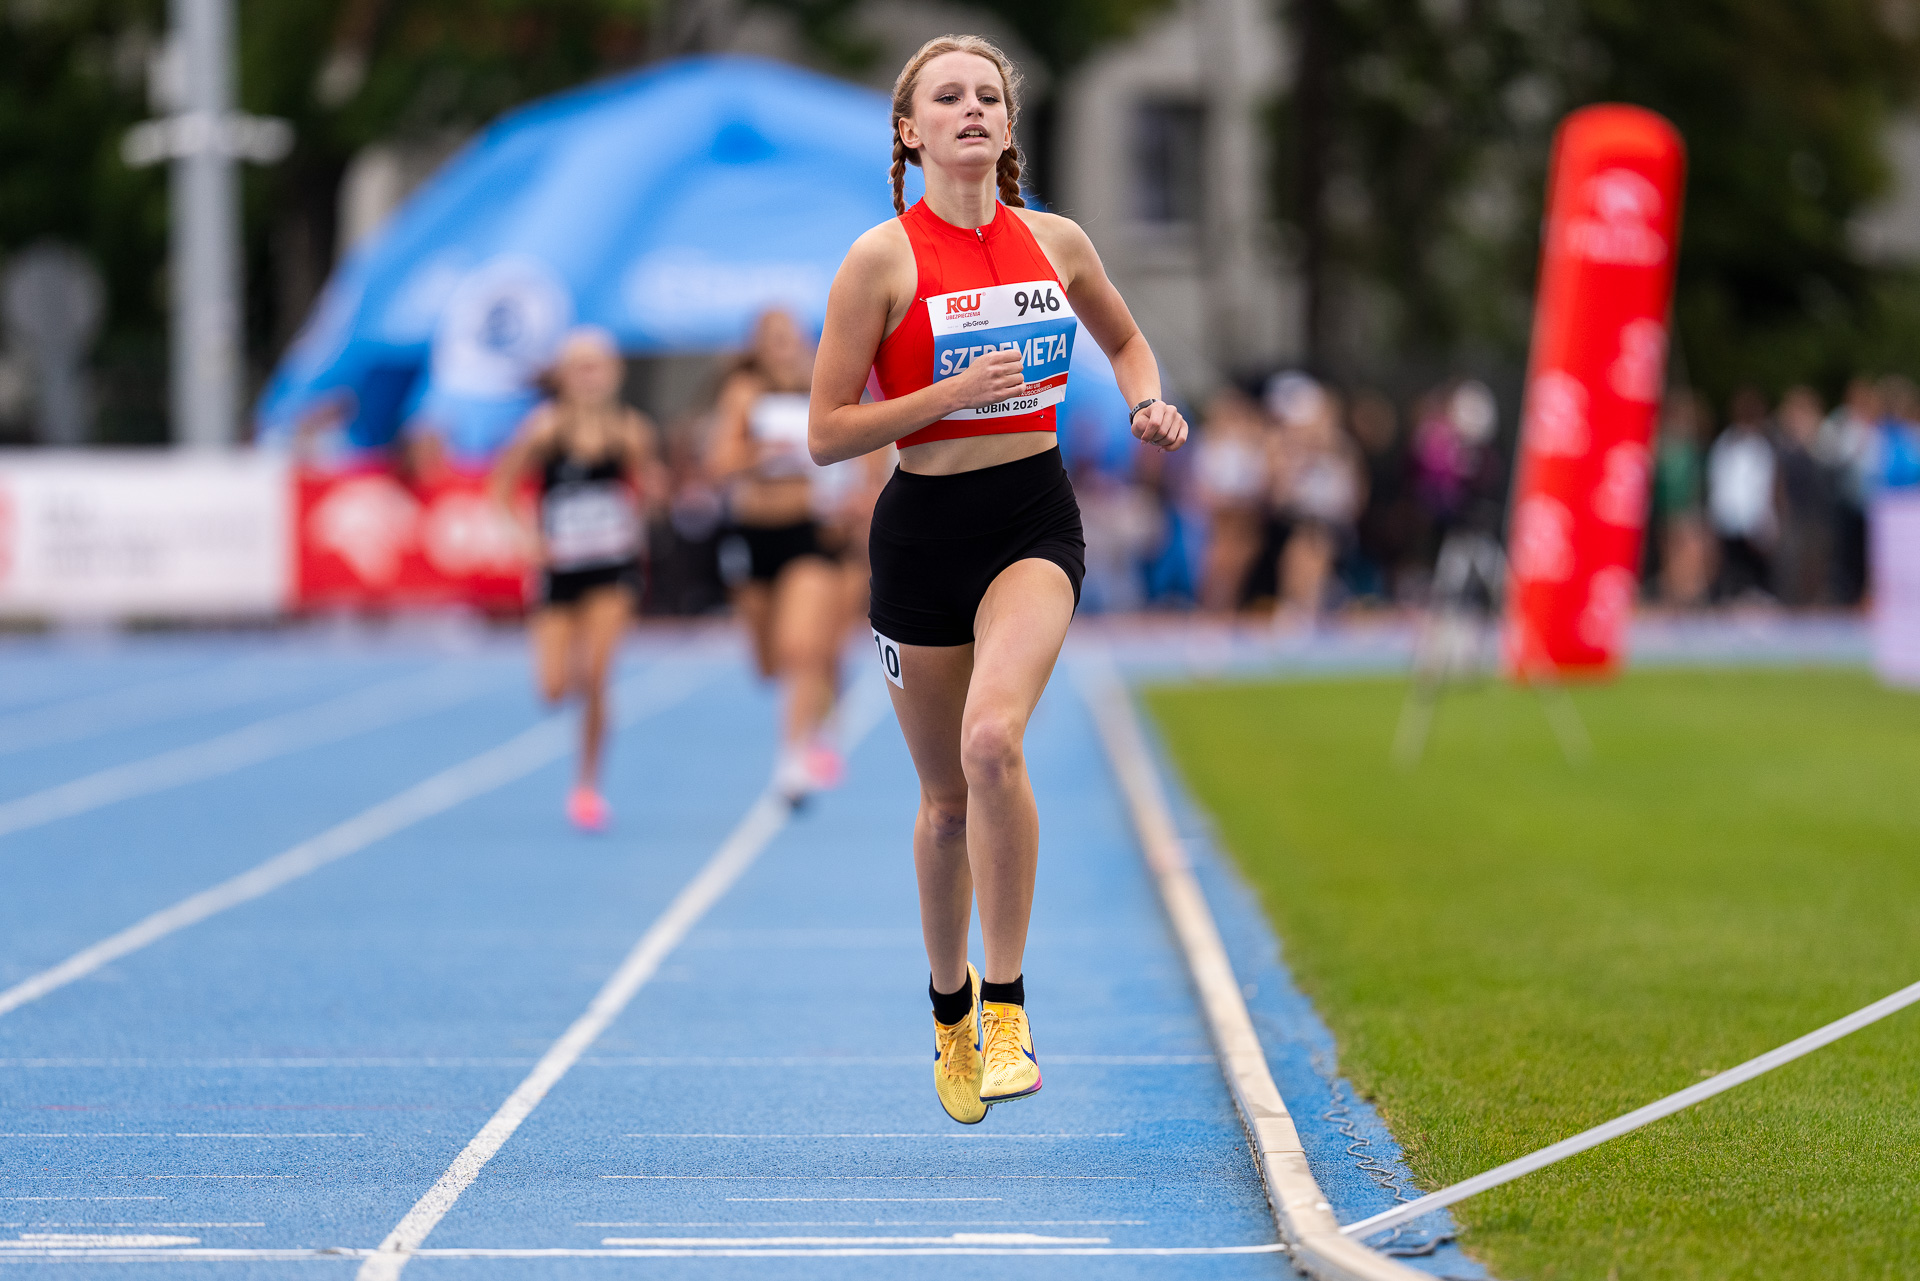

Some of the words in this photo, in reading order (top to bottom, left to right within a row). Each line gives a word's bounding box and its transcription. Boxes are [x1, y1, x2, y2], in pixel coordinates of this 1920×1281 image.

[946, 293, 982, 314] RCU
[1014, 288, 1060, 317] 946
[1013, 398, 1039, 410] 2026
[875, 634, 900, 678] 10
